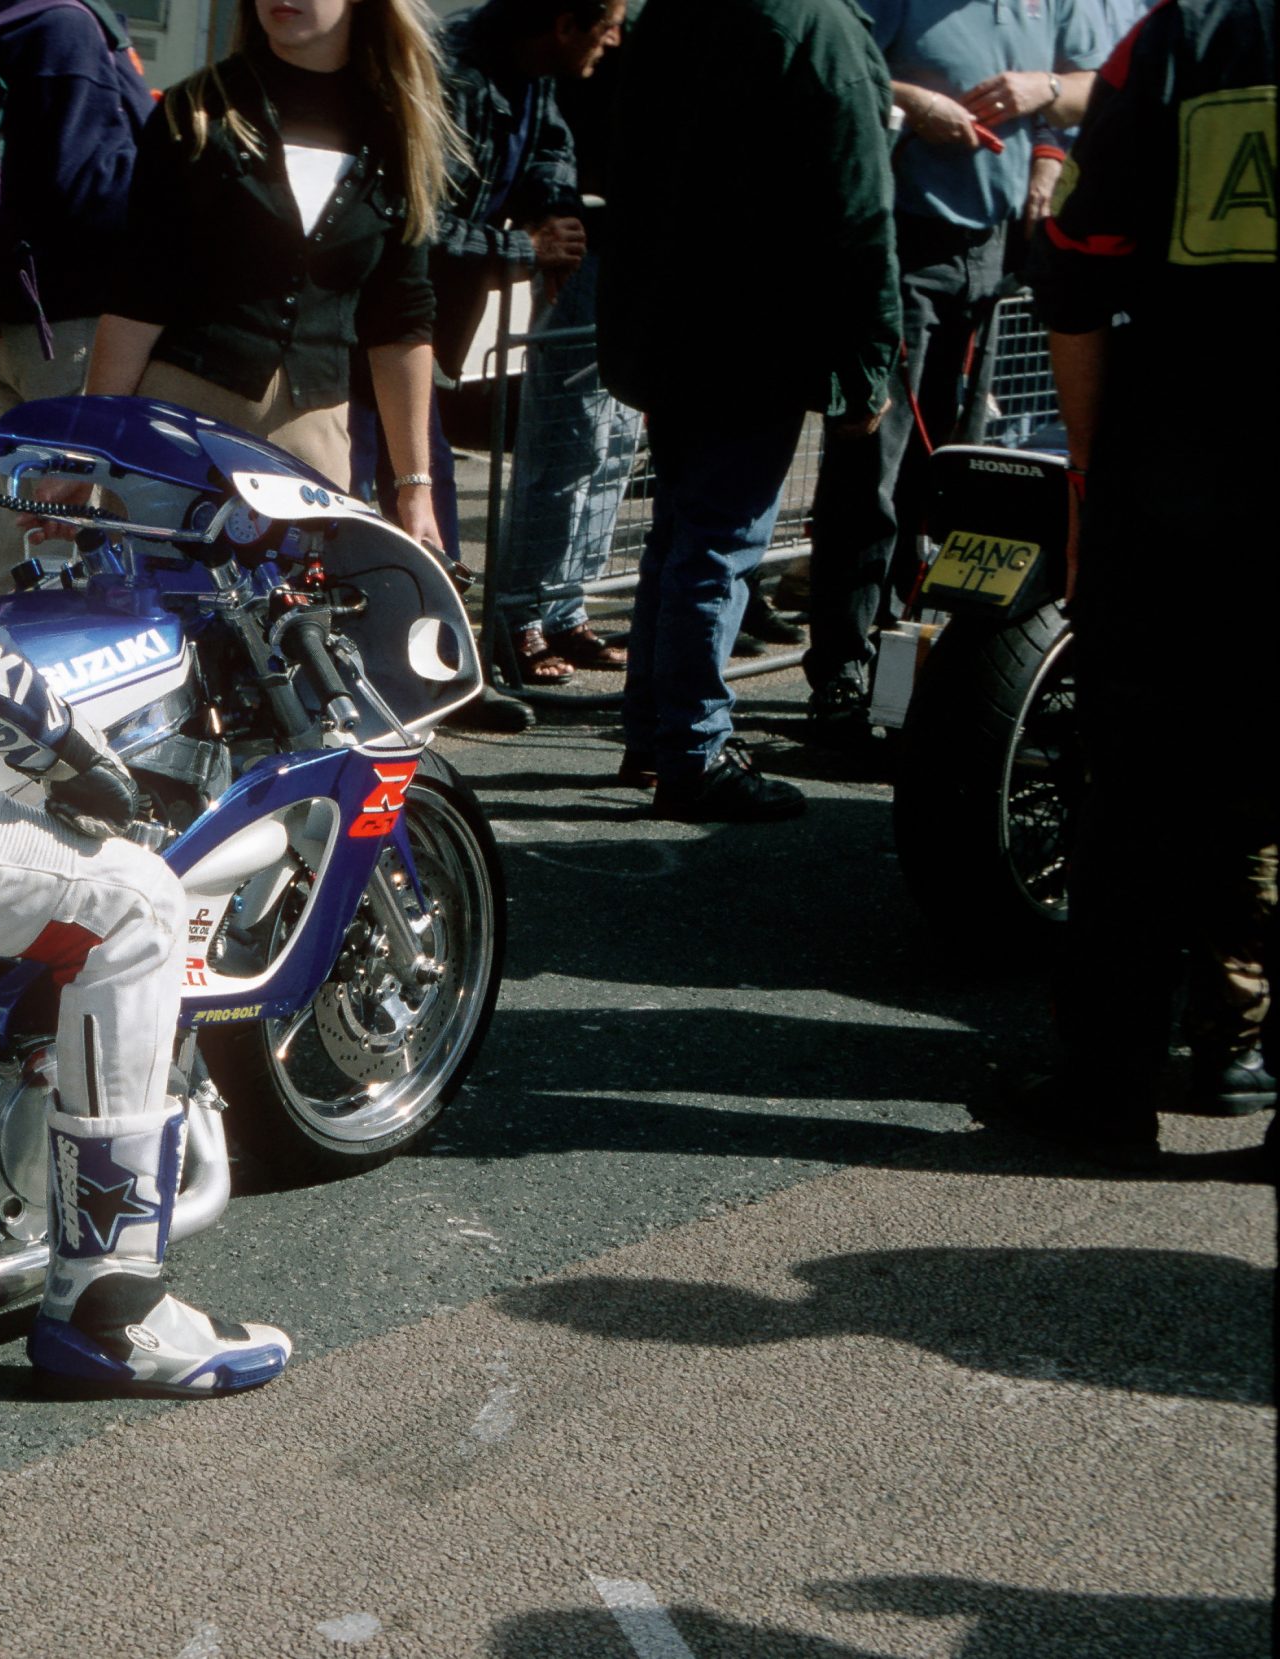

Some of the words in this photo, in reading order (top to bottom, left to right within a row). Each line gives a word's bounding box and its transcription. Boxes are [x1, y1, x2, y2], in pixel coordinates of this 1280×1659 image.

[1208, 131, 1277, 220] A
[969, 459, 1045, 478] HONDA
[37, 628, 170, 697] SUZUKI
